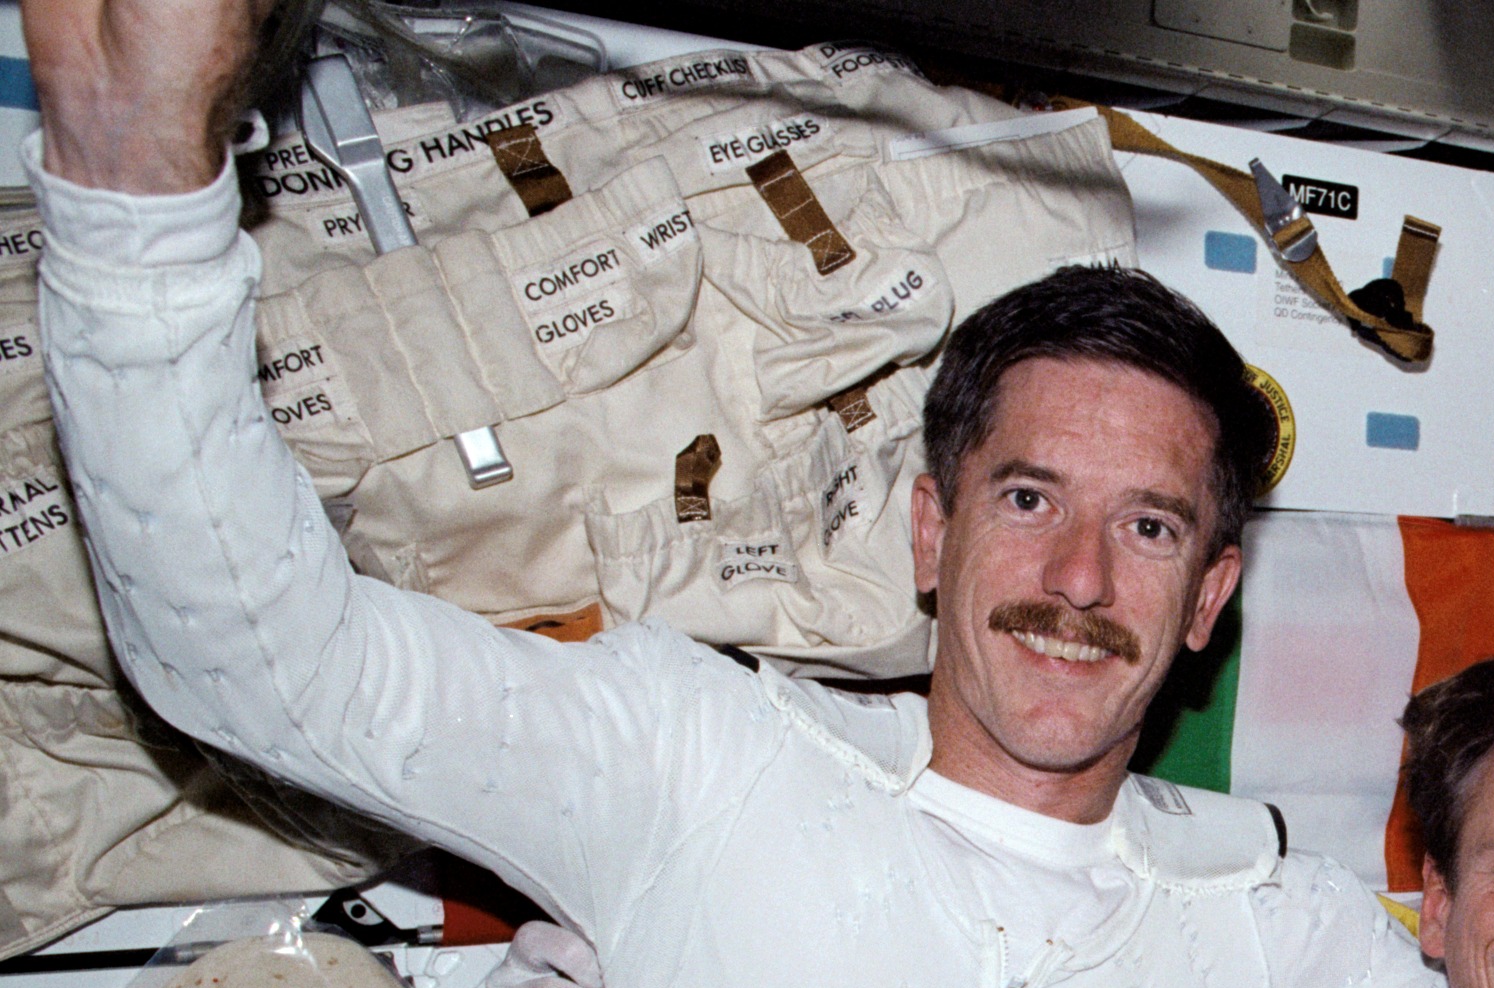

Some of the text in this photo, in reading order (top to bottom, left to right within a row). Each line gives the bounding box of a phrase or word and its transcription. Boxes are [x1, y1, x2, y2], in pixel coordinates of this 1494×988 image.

[622, 75, 664, 99] CUFF
[709, 120, 821, 163] EYE GLASSES
[257, 150, 413, 197] DONNG
[1289, 183, 1351, 211] MF71C
[323, 213, 361, 237] PRY
[640, 210, 696, 250] WRIST
[525, 249, 620, 301] COMFORT
[871, 270, 923, 313] PLUG
[535, 300, 615, 343] GLOVES
[257, 345, 324, 382] MFORT
[271, 393, 332, 424] OVES
[1260, 380, 1290, 423] JUSTICE
[1264, 434, 1291, 481] ARSHAL
[735, 544, 779, 557] LEFT
[721, 562, 787, 581] GLOVE
